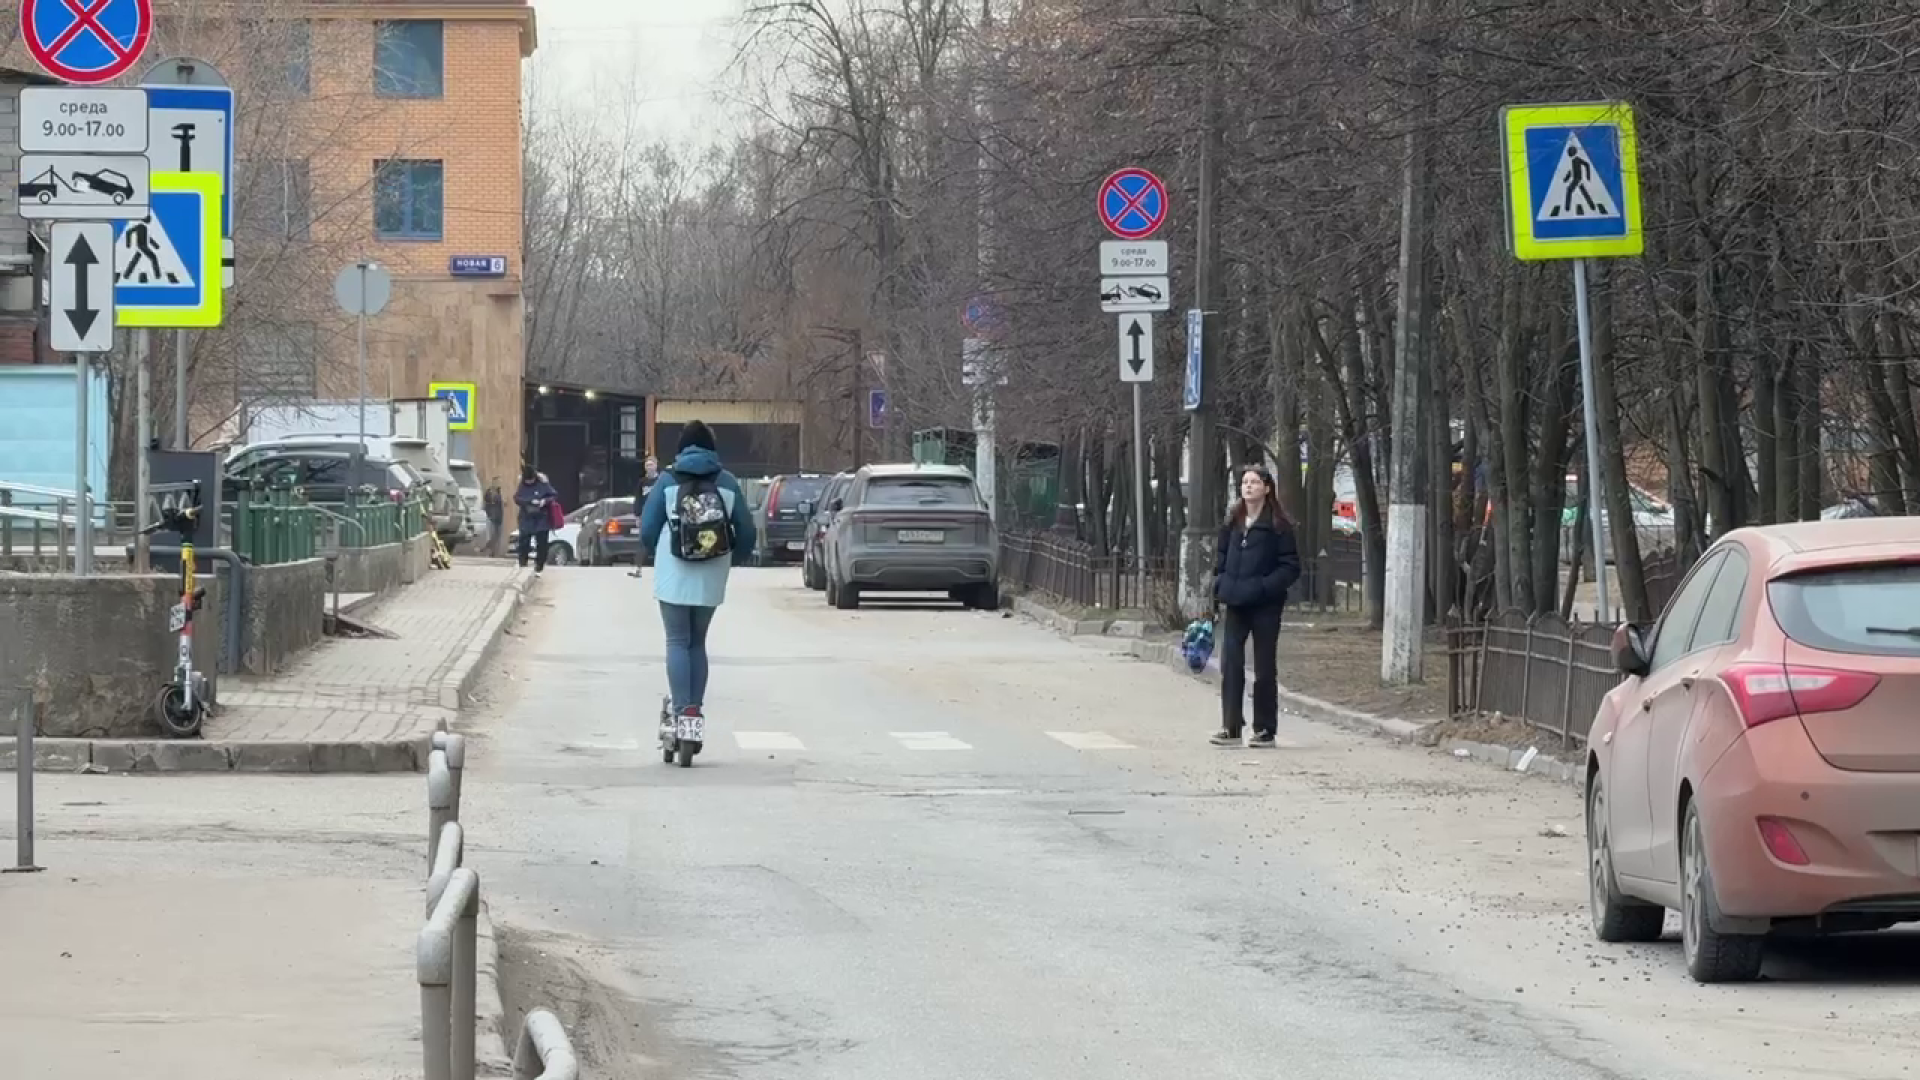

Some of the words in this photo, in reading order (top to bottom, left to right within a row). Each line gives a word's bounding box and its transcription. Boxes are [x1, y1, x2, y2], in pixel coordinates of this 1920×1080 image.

[59, 102, 108, 116] среда
[42, 120, 124, 136] 9.00-17.00
[1111, 258, 1156, 267] 9.00-17.00
